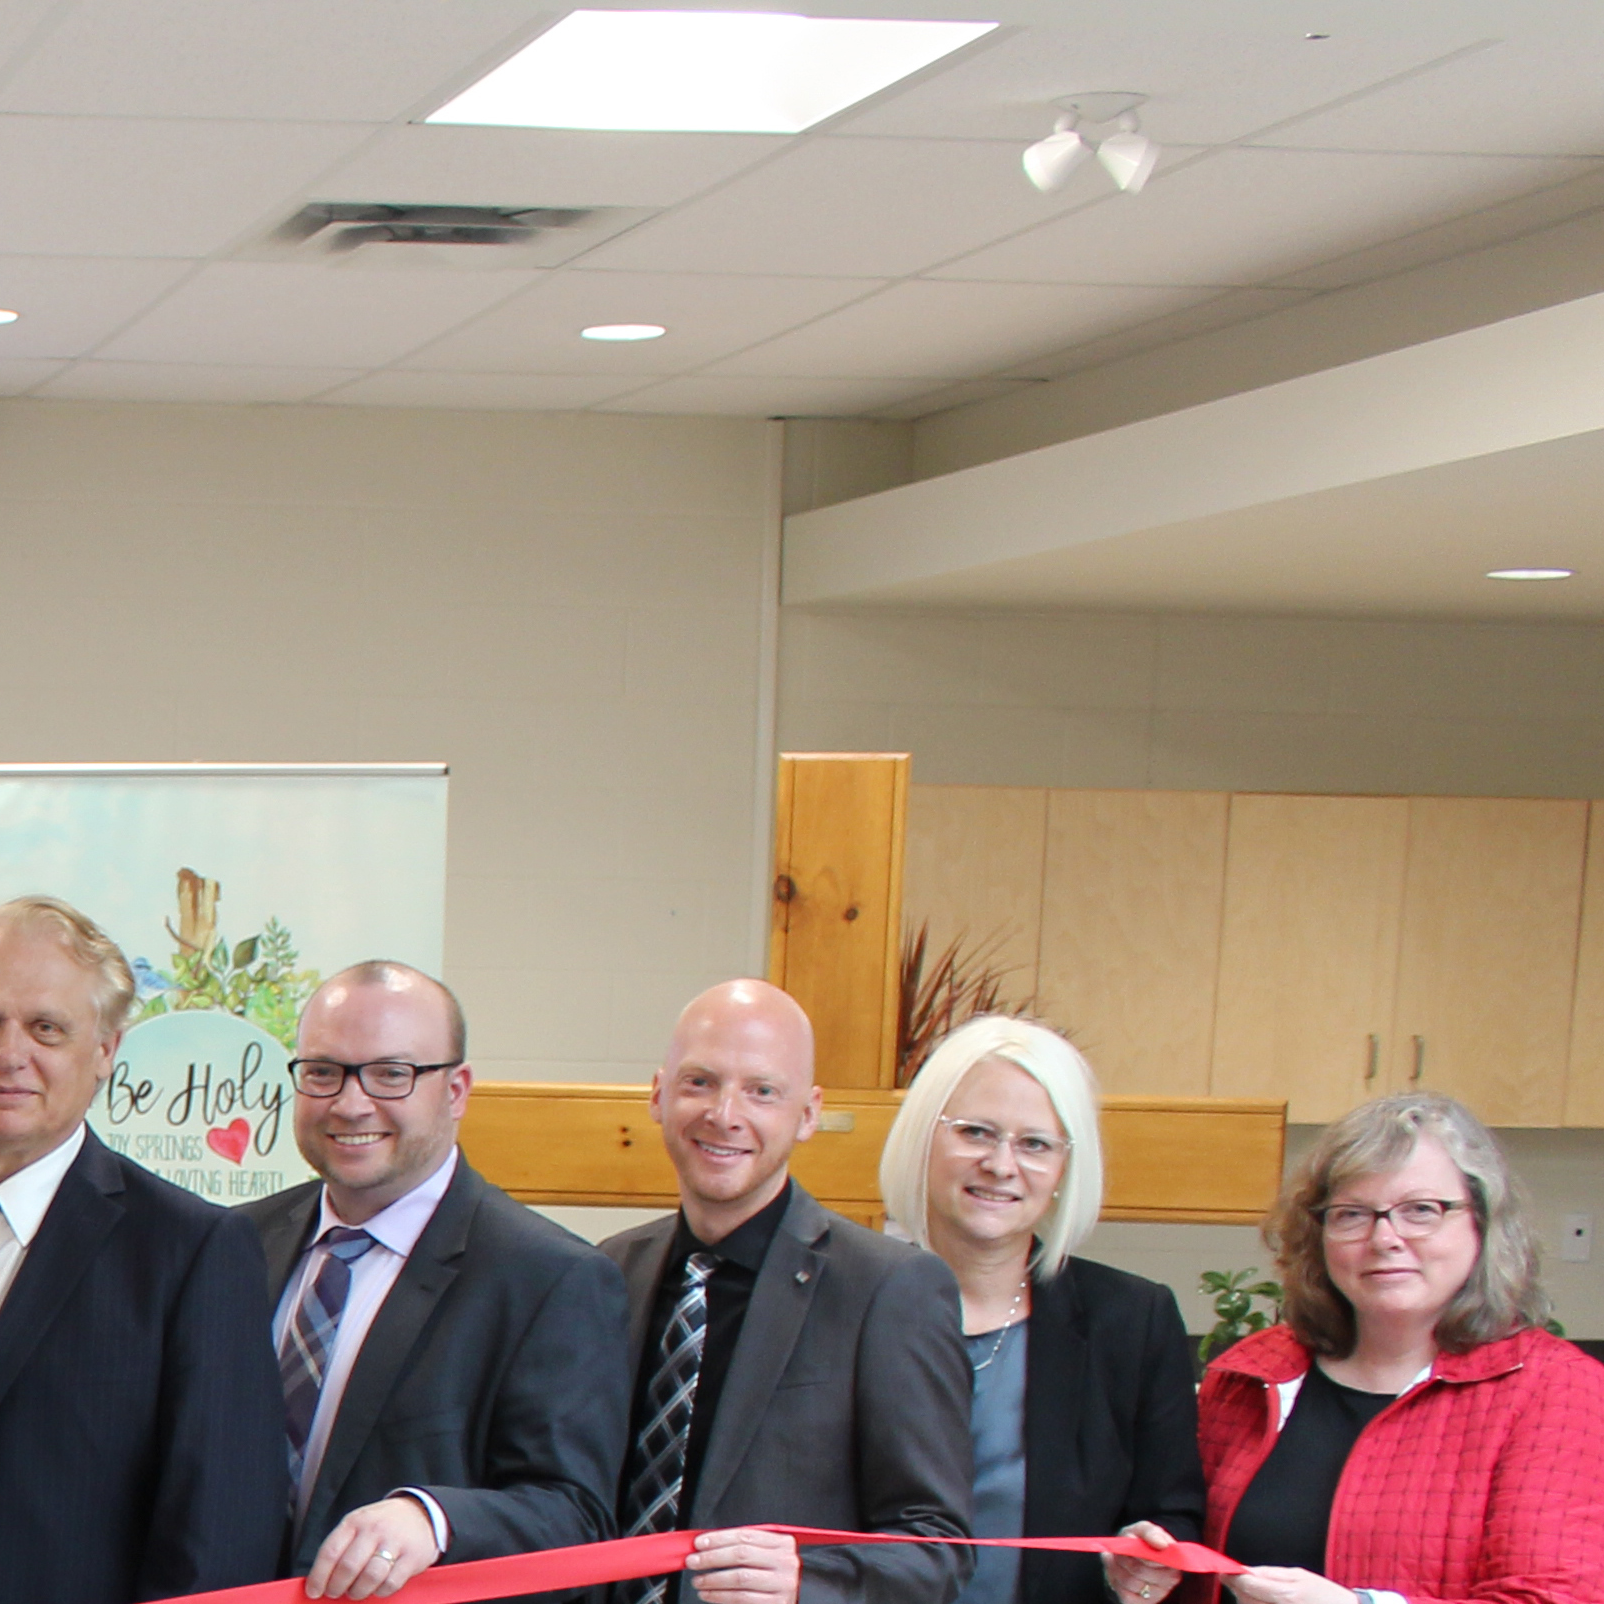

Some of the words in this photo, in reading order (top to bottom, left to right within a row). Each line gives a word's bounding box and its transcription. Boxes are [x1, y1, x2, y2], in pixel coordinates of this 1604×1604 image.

[107, 1061, 164, 1125] Be
[167, 1041, 293, 1157] Holy
[135, 1133, 204, 1161] SPRINGS
[228, 1169, 283, 1197] HEART!
